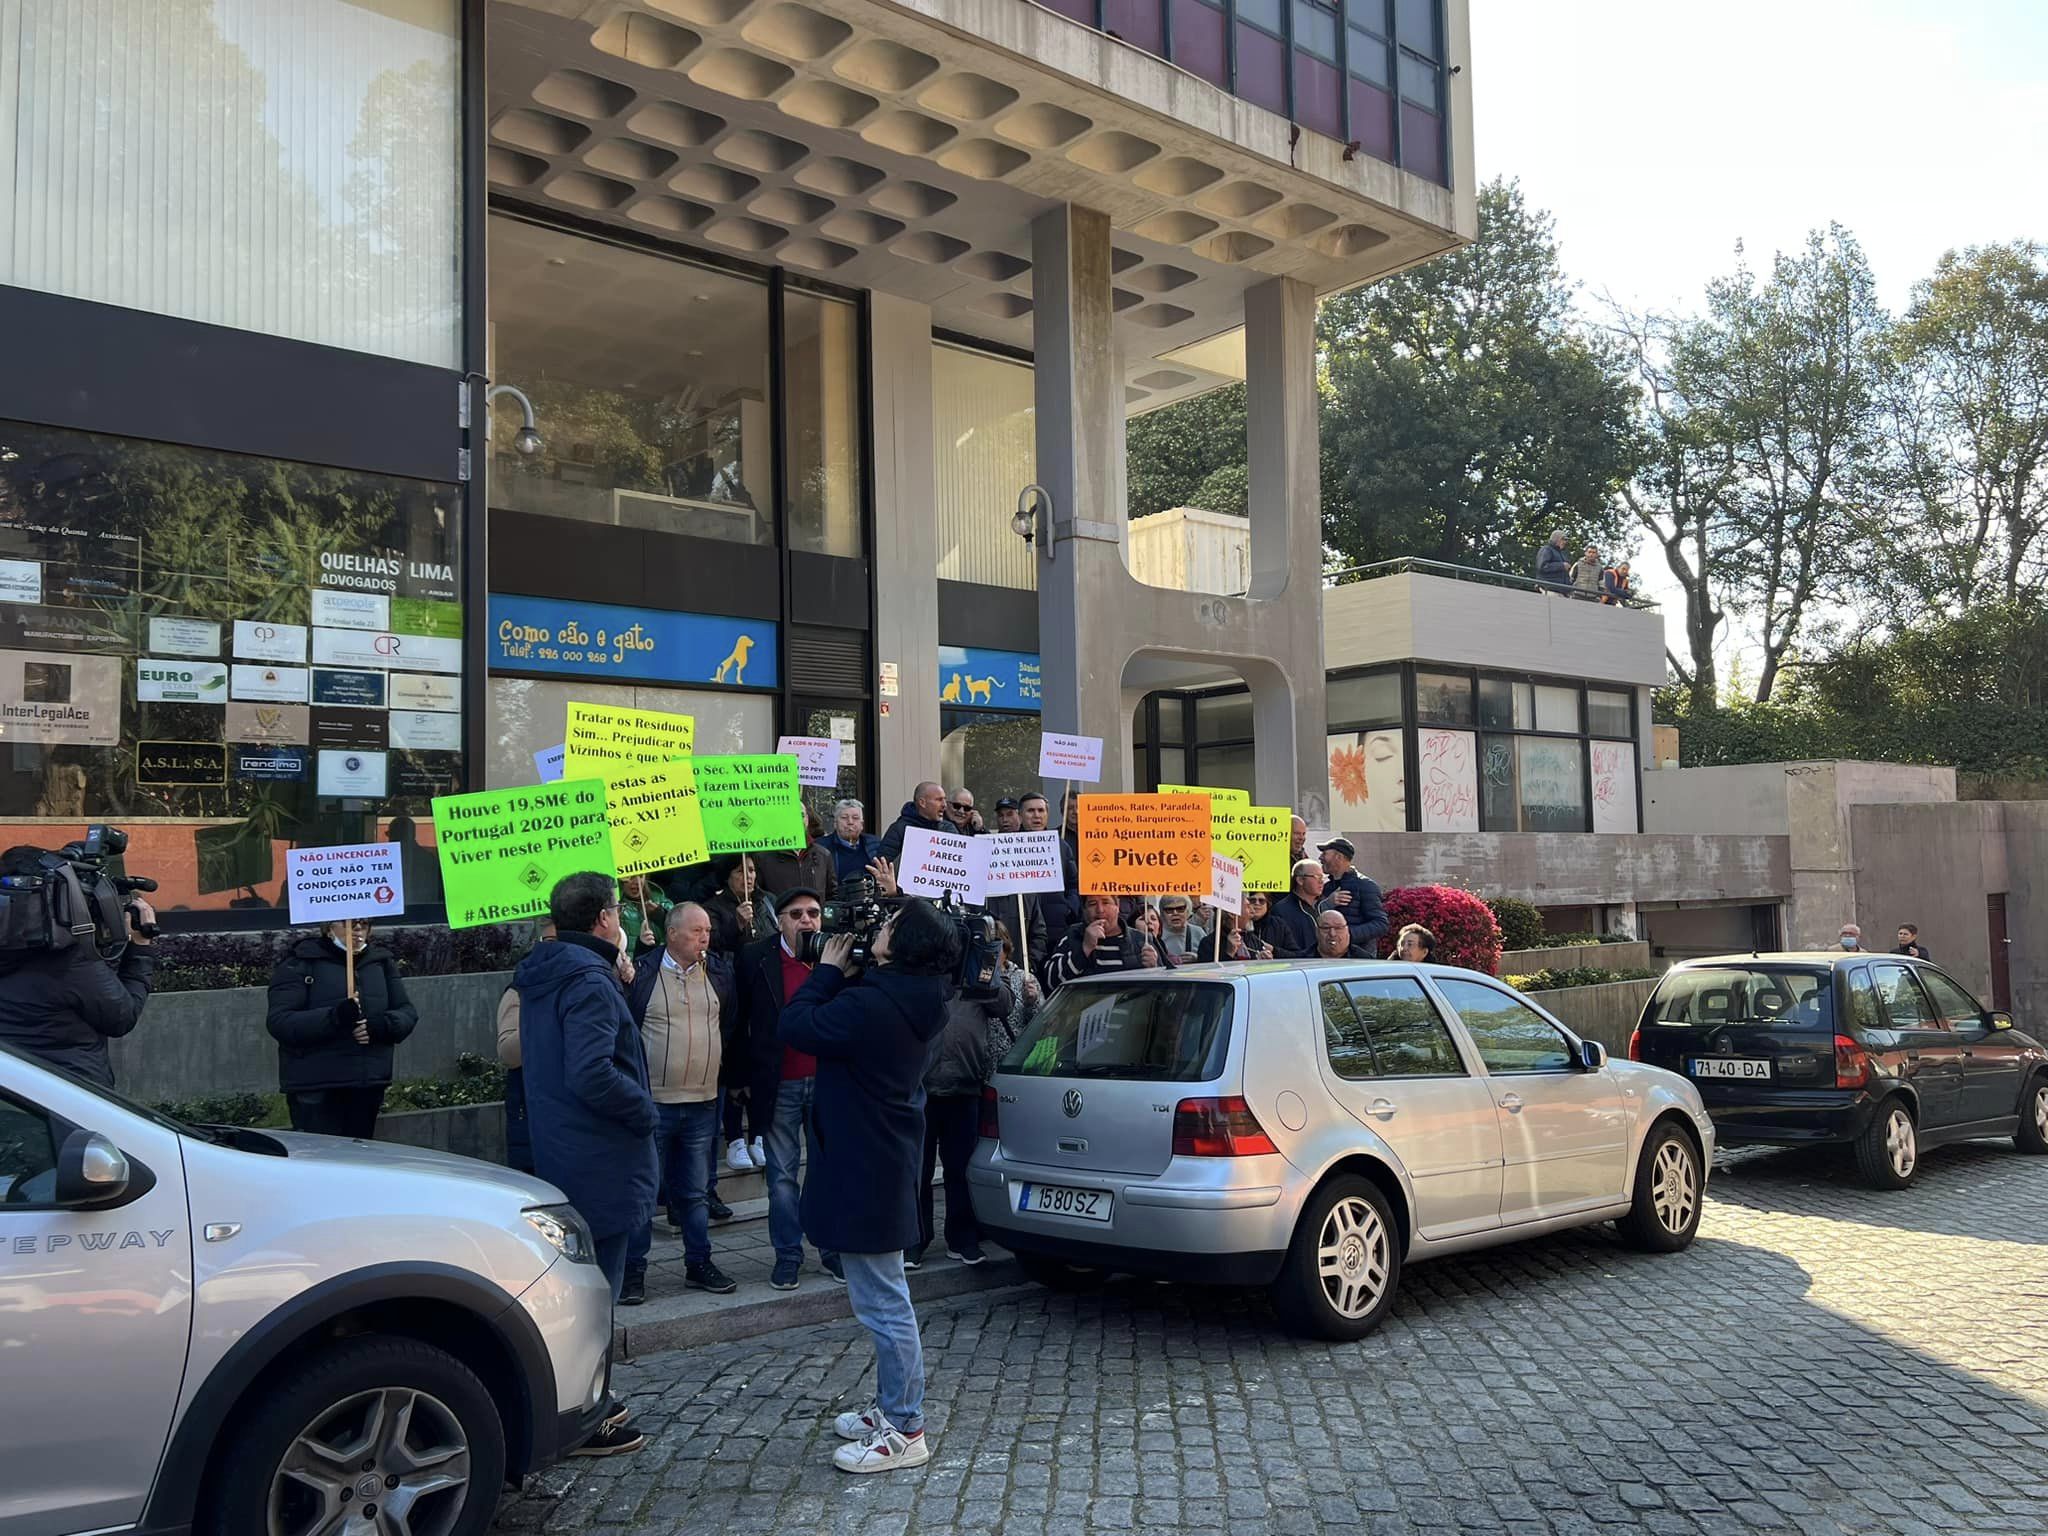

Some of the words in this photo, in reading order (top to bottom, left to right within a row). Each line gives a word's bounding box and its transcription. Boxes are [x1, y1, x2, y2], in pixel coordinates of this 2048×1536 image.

[320, 552, 400, 576] QUELHAS
[410, 562, 454, 582] LIMA
[320, 573, 397, 591] ADVOGADOS
[499, 620, 550, 643] Como
[557, 621, 589, 646] cão
[596, 630, 607, 647] e
[612, 623, 655, 664] gato
[500, 641, 535, 660] Telef:
[562, 649, 583, 662] 000
[140, 670, 193, 682] EURO
[2, 703, 90, 721] InterLegalAce
[575, 710, 614, 725] Tratar
[617, 717, 632, 728] os
[572, 727, 608, 742] Sim...
[612, 731, 676, 749] Prejudicar
[679, 740, 692, 751] os
[570, 744, 622, 760] Vizinhos
[636, 754, 659, 764] que
[732, 763, 753, 775] XXI
[756, 762, 789, 774] ainda
[610, 776, 647, 791] estas
[651, 773, 667, 785] as
[704, 780, 741, 792] fazem
[743, 779, 790, 791] Lixeiras
[620, 785, 696, 808] Ambientais
[449, 802, 501, 821] Houve
[507, 792, 570, 814] 19,8M€
[575, 790, 595, 804] do
[1087, 802, 1127, 813] Laundos,
[1130, 803, 1158, 813] Rates,
[1160, 802, 1204, 813] Paradela,
[636, 808, 660, 824] XXI
[1096, 814, 1133, 825] Cristelo,
[1136, 815, 1195, 826] Barqueiros...
[1210, 812, 1236, 825] nde
[1239, 812, 1266, 826] está
[1270, 816, 1278, 826] o
[441, 821, 516, 844] Portugal
[520, 814, 565, 833] 2020
[570, 812, 606, 828] para
[1085, 829, 1109, 840] não
[1112, 828, 1176, 841] Aguentam
[1180, 828, 1206, 840] este
[707, 836, 798, 851] ResulixoFede!
[998, 836, 1014, 845] NÃO
[1015, 836, 1026, 844] SE
[1027, 834, 1056, 843] REDUZ!
[1226, 830, 1289, 843] Governo?!
[300, 851, 324, 862] NÃO
[326, 848, 389, 861] LINCENCIAR
[450, 848, 493, 865] Viver
[499, 841, 543, 859] neste
[547, 831, 603, 852] Pivete?
[1001, 847, 1012, 855] SE
[1013, 845, 1046, 855] RECICLA
[616, 850, 700, 875] sulixoFede!
[929, 850, 963, 863] PARECE
[999, 860, 1010, 868] SE
[1012, 858, 1049, 869] VALORIZA
[1113, 848, 1179, 867] Pivete
[296, 869, 304, 877] O
[312, 866, 333, 877] QUE
[340, 863, 364, 874] NÃO
[371, 862, 393, 872] TEM
[921, 863, 967, 878] ALIENADO
[995, 872, 1007, 880] SE
[1009, 869, 1052, 880] DESPREZA
[359, 876, 388, 886] PARA
[913, 875, 927, 885] DO
[928, 877, 971, 893] ASSUNTO
[1091, 880, 1202, 893] #AResulixoFede!
[309, 891, 372, 905] FUNCIONAR
[464, 897, 551, 923] #AResulix
[0, 1229, 175, 1256] EPWAY
